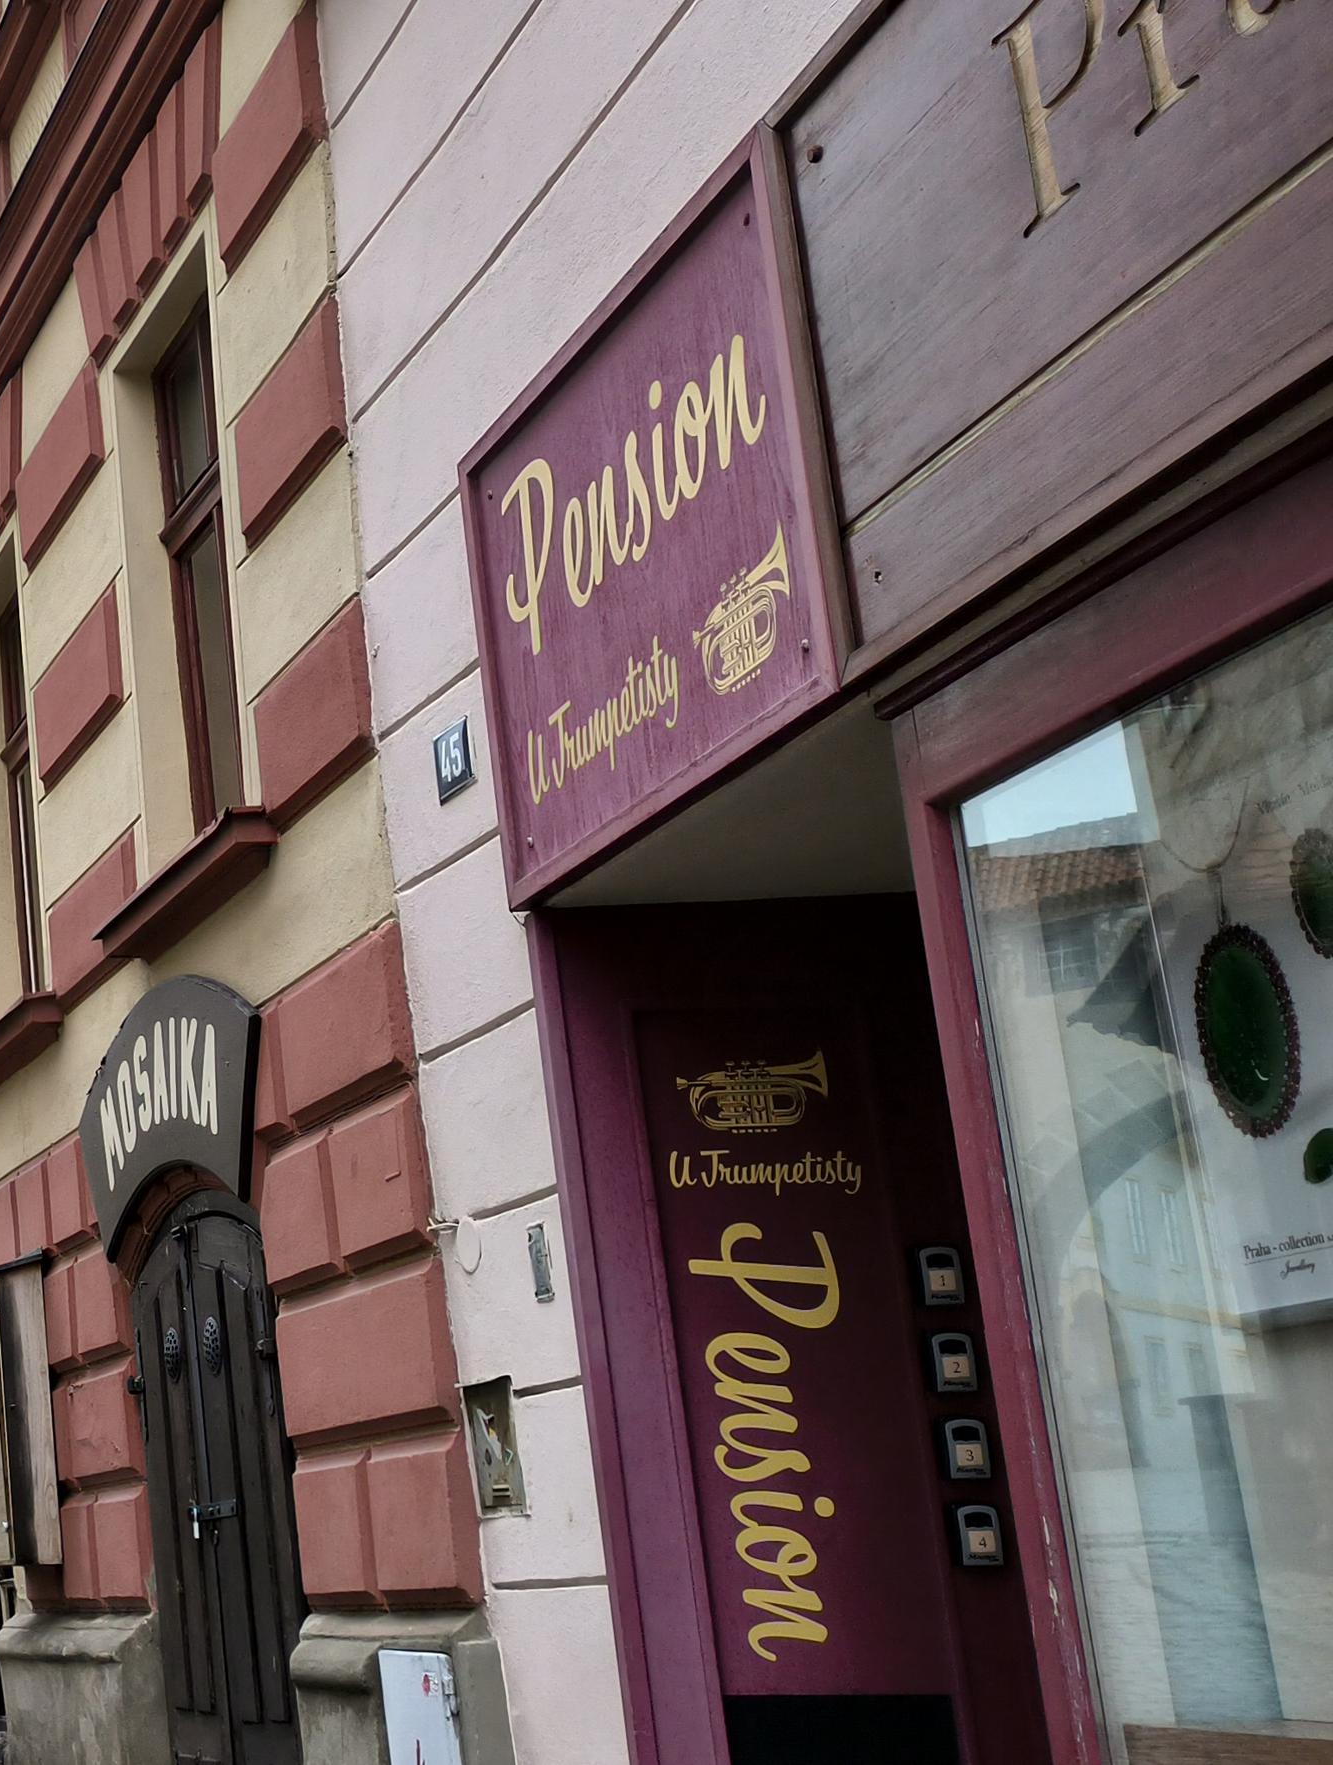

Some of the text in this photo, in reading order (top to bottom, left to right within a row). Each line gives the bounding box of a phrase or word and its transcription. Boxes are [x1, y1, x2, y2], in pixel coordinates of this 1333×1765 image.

[991, 0, 1288, 238] Pr
[502, 334, 766, 655] Pension
[528, 637, 680, 805] U Trumpetisty
[441, 731, 462, 782] 45
[100, 1016, 218, 1192] MOSAIKA
[669, 1149, 862, 1195] U Trumpetisty
[1243, 1241, 1272, 1259] Praha
[1278, 1231, 1326, 1252] collection
[952, 1361, 962, 1374] 2
[689, 1222, 840, 1662] Pension
[965, 1449, 975, 1462] 3
[978, 1536, 987, 1549] 4
